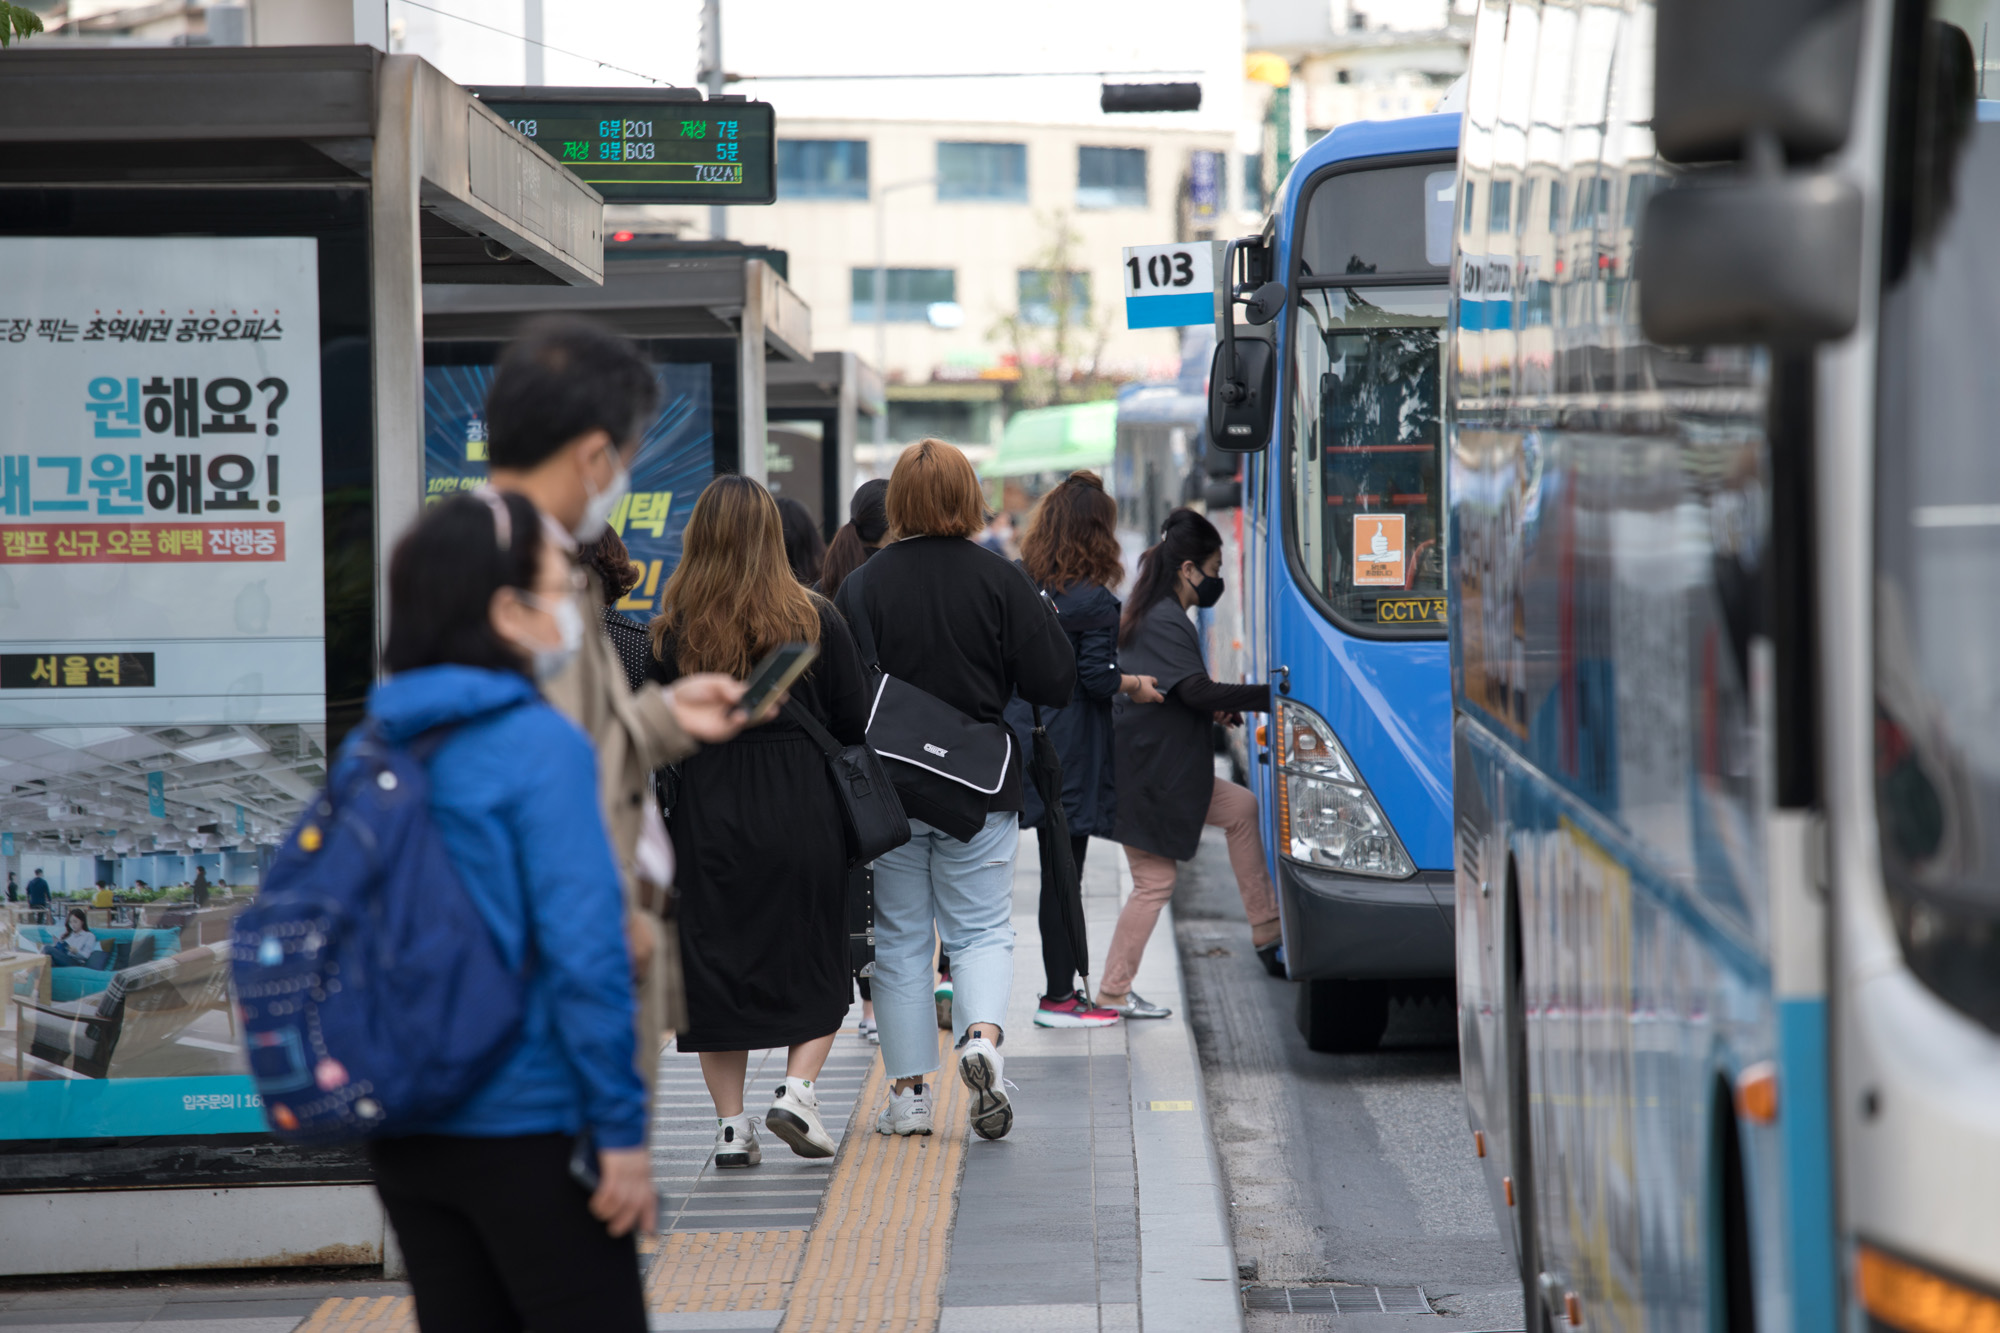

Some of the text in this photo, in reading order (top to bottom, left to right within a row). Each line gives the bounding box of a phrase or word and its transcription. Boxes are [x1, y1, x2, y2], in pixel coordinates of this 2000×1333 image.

[599, 120, 621, 139] 6분
[626, 120, 739, 140] 201 저상 7분
[563, 140, 621, 161] 저상 9분
[626, 142, 739, 161] 603 5분
[1126, 252, 1194, 289] 103
[37, 318, 79, 342] 찍는
[82, 318, 173, 342] 초역세권
[176, 318, 283, 342] 공유오피스
[85, 376, 289, 438] 원해요?
[2, 528, 277, 557] 캠프 신규 오픈 혜택 진행중
[1381, 600, 1431, 620] CCTV
[31, 655, 121, 686] 서울역
[182, 1094, 235, 1110] 입주문의
